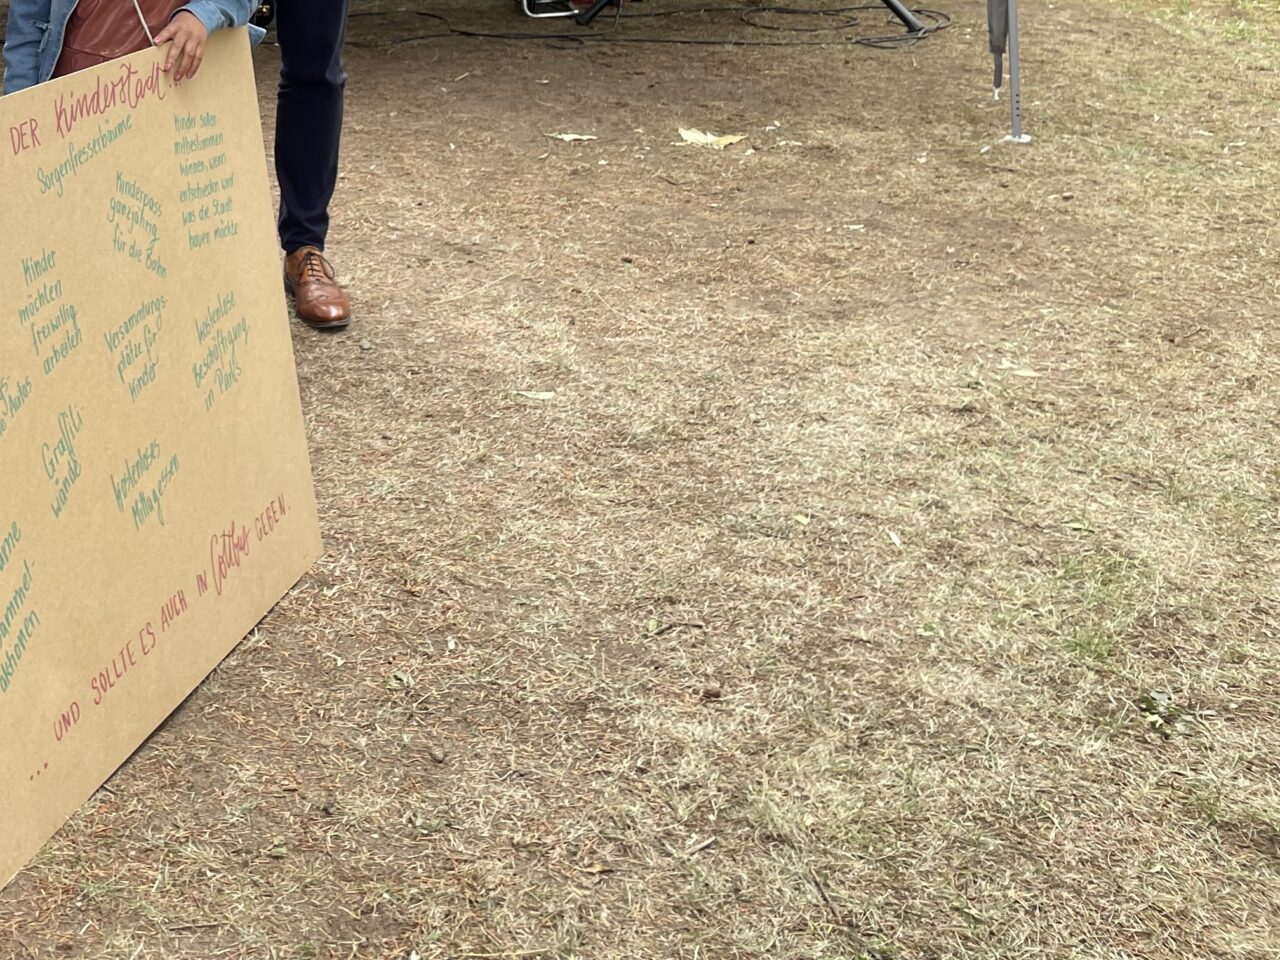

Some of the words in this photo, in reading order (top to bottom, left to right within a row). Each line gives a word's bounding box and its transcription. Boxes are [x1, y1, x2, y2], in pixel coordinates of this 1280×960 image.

[9, 117, 42, 157] DER
[113, 222, 126, 253] für
[128, 239, 142, 263] die
[146, 248, 167, 279] Bahn
[17, 279, 63, 327] möchten
[43, 327, 83, 376] arbeiten
[143, 323, 158, 362] für
[7, 376, 34, 418] Autos
[203, 389, 215, 412] in
[52, 701, 81, 742] UND
[90, 639, 138, 706] SOLLTE
[139, 621, 157, 656] ES
[160, 588, 188, 633] AUCH
[195, 570, 208, 597] IN
[209, 520, 252, 597] Cottbus
